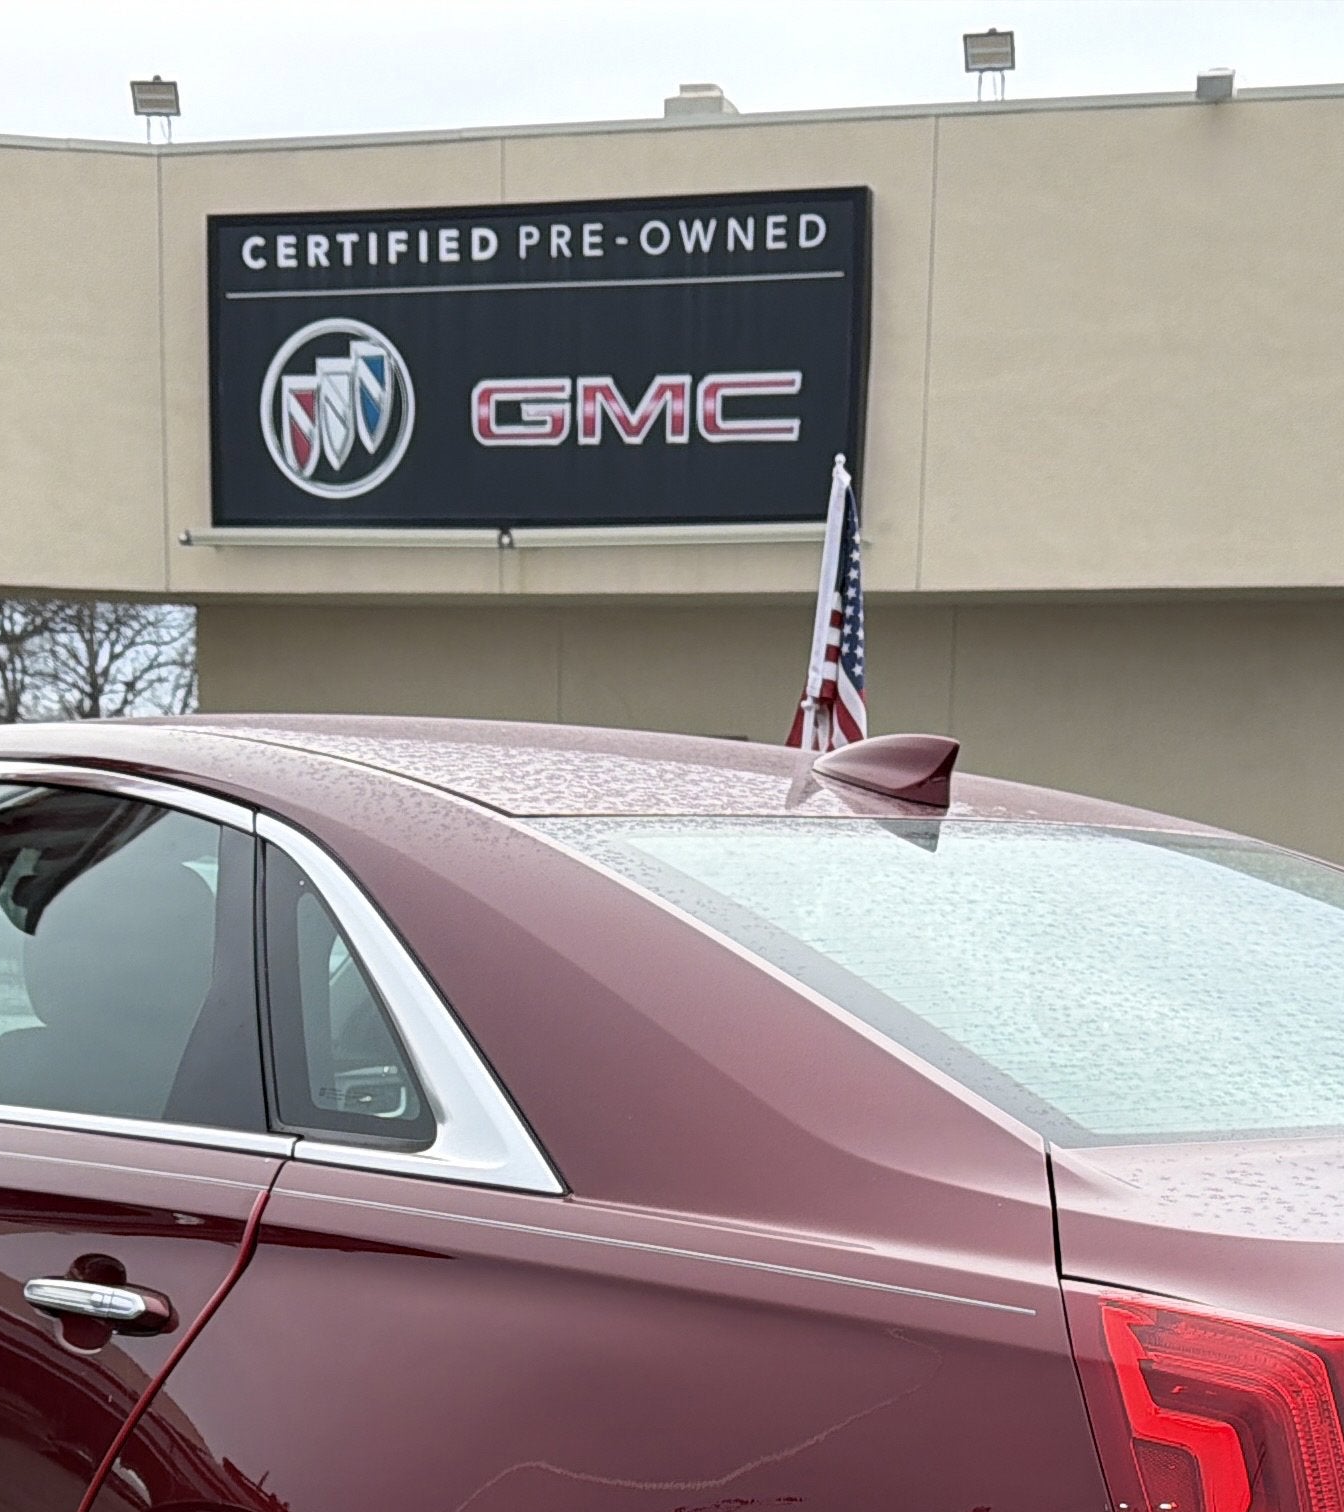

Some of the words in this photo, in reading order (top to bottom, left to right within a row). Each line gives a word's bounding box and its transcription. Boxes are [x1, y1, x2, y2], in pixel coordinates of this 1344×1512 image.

[242, 227, 498, 270] CERTIFIED
[519, 213, 827, 259] PRE-OWNED
[471, 371, 802, 446] GMC
